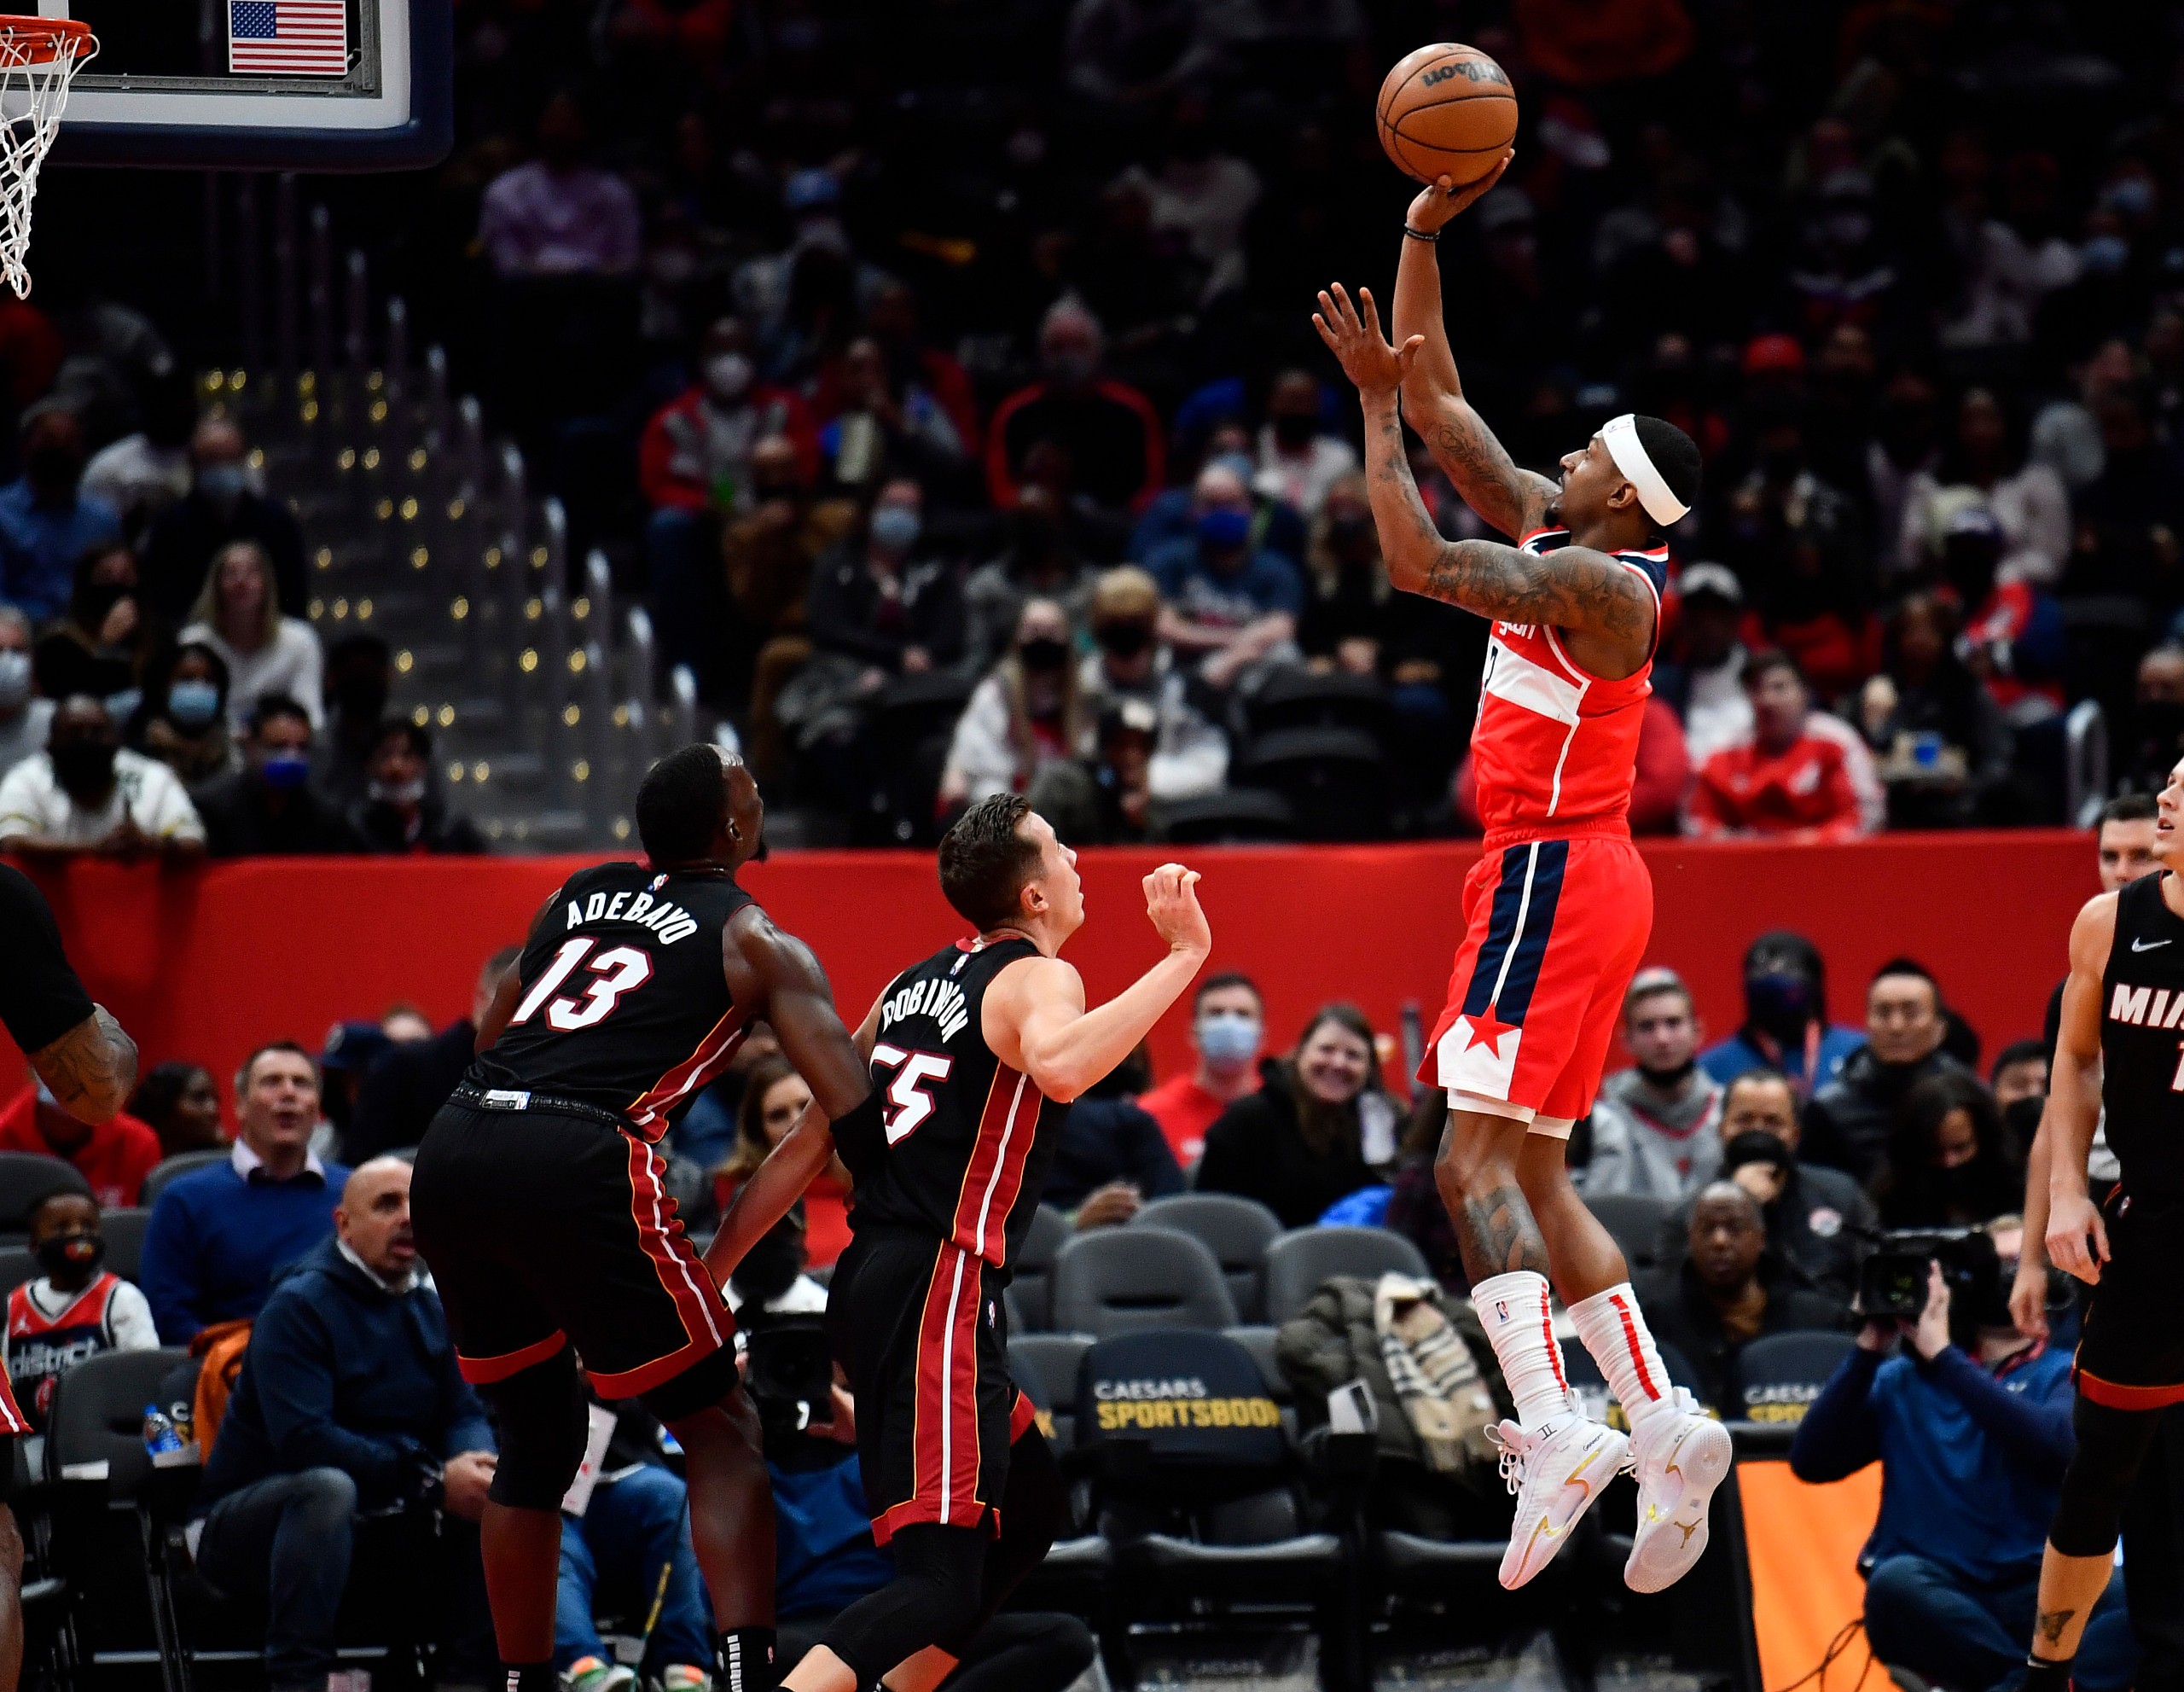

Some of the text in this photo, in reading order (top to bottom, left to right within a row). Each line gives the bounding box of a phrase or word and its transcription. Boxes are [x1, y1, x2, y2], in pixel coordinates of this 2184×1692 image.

[566, 892, 698, 945] ADEBAYO
[510, 935, 654, 1032] 13
[1094, 1376, 1206, 1399] CAESARS
[1744, 1384, 1821, 1404] CAESA
